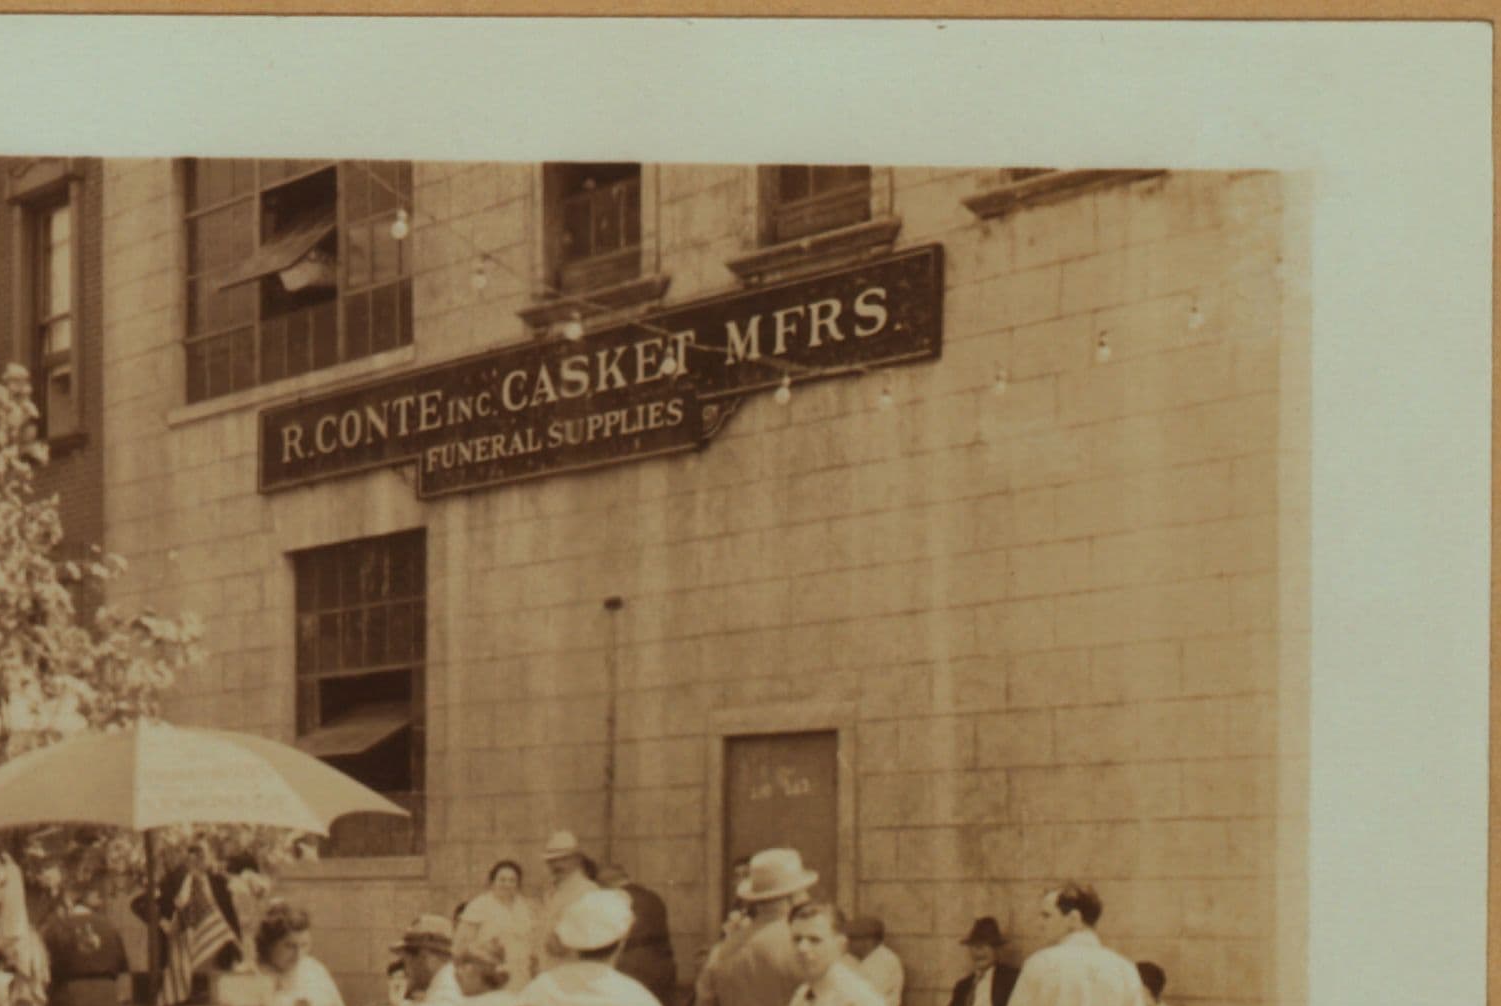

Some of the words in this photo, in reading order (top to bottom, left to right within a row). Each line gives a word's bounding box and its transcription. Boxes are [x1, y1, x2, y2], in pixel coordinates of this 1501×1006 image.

[447, 392, 499, 425] INC.
[502, 329, 695, 412] CASKET
[724, 287, 903, 366] MFRS.
[425, 427, 543, 473] FUNERAL
[547, 398, 684, 447] SUPPLIES
